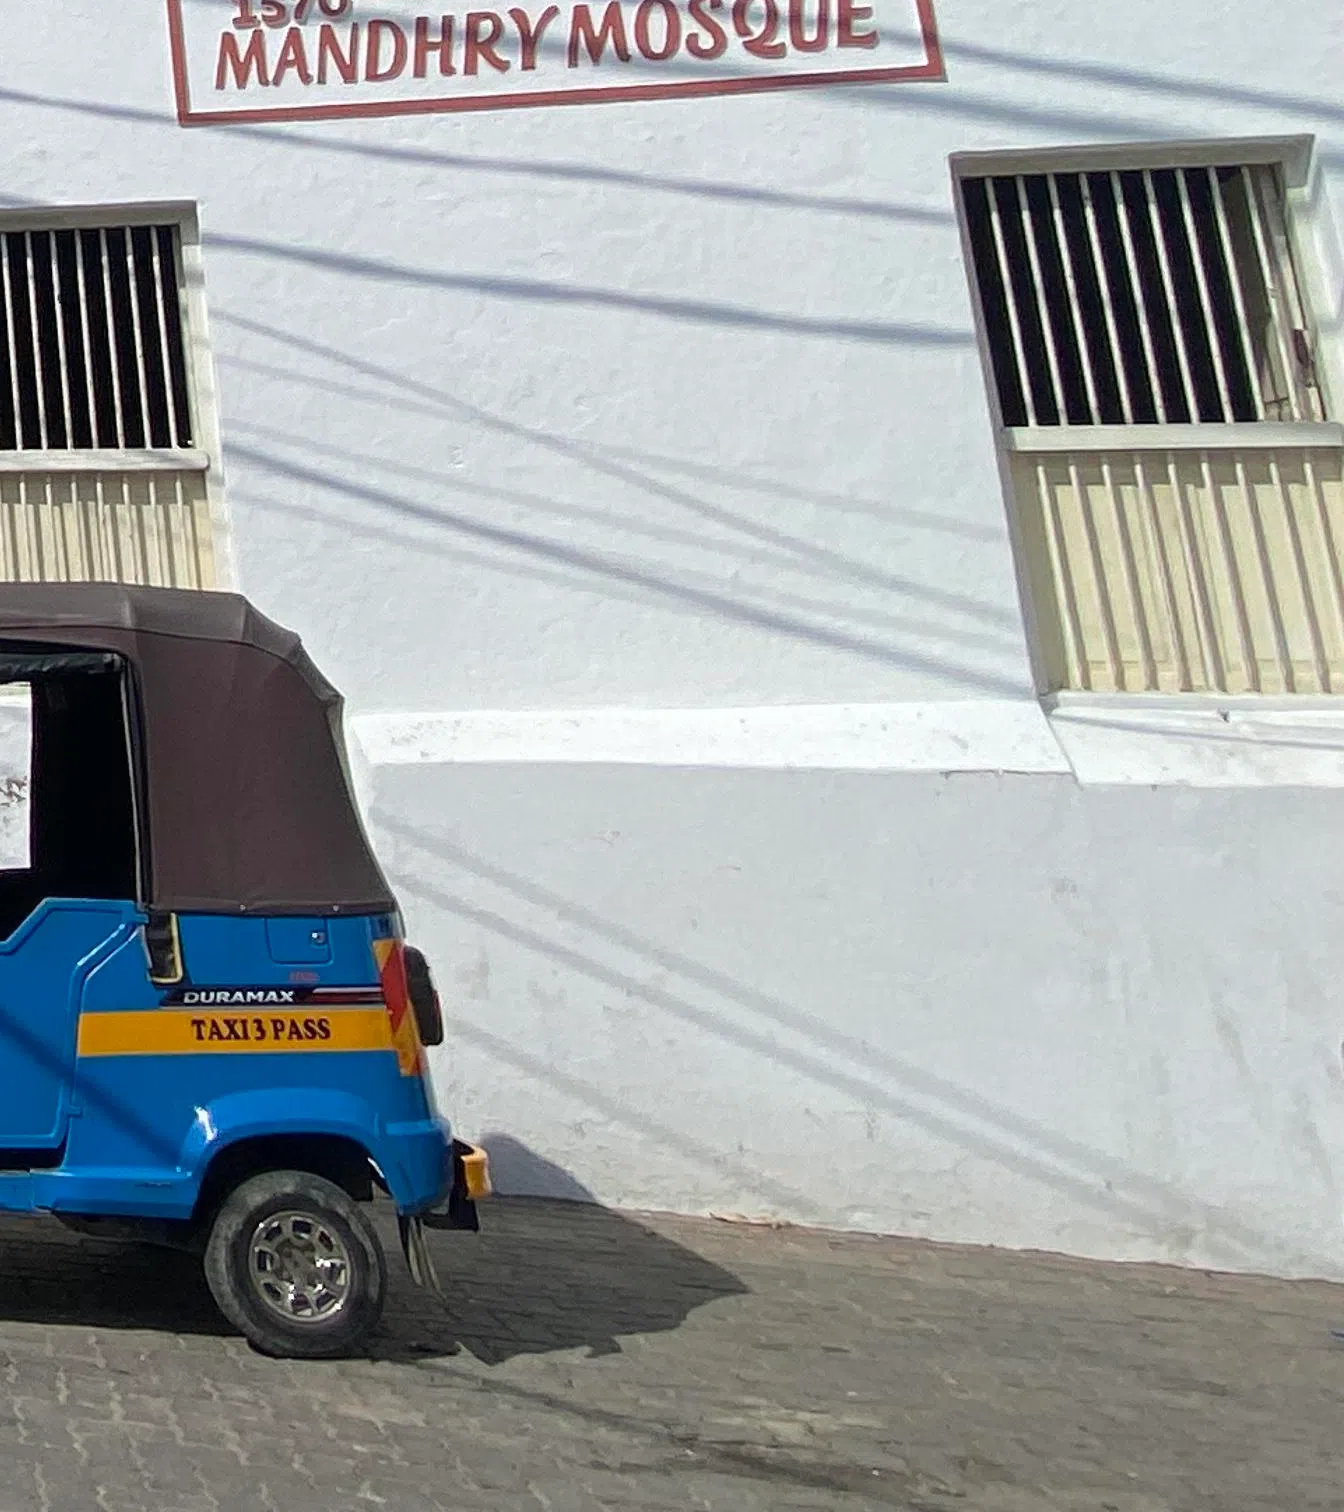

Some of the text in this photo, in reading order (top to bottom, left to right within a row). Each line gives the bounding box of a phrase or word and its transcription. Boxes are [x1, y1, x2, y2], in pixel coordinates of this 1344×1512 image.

[215, 4, 561, 90] MANDHRY
[183, 990, 295, 1004] DURAMAX
[191, 1018, 332, 1042] TAXI 3 PASS
